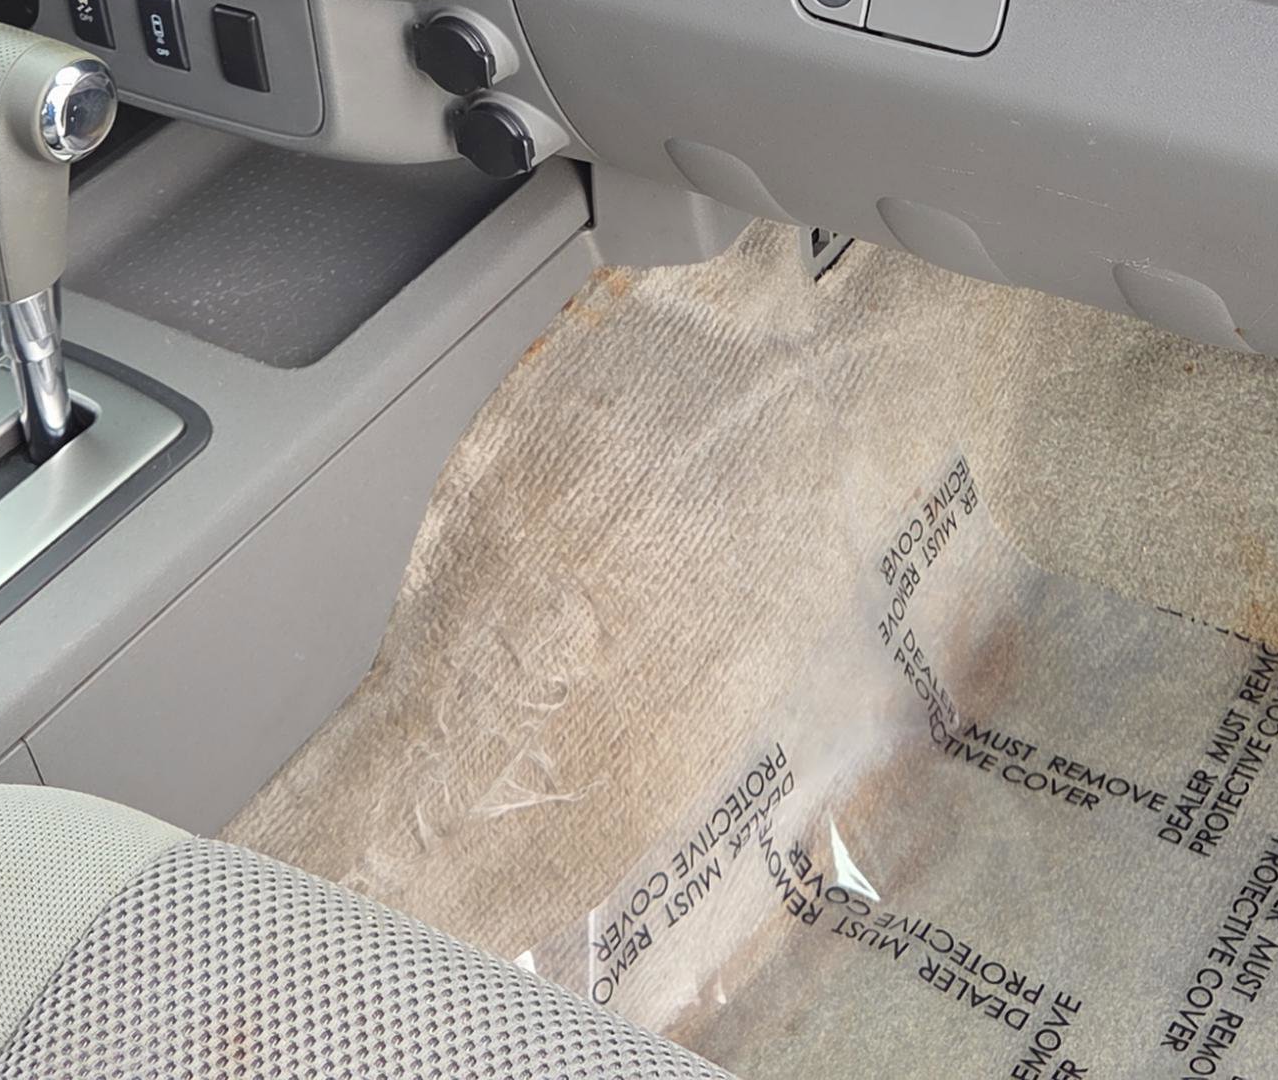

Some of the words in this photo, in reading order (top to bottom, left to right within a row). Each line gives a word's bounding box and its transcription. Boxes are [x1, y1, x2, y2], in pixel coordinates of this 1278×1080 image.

[879, 519, 923, 586] COVER
[922, 510, 958, 568] MUST
[878, 562, 921, 646] REMOVE
[894, 647, 998, 772] PROTECTIVE
[1002, 764, 1101, 812] COVER
[964, 723, 1037, 762] MUST
[1047, 755, 1168, 813] REMOVE
[672, 742, 788, 880] PROTECTIVE
[1157, 769, 1219, 845] DEALER
[1205, 708, 1251, 764] MUST
[1188, 736, 1272, 857] PROTECTIVE
[664, 857, 722, 929] MUST
[759, 820, 824, 926] REMOVE
[788, 840, 871, 916] COVER
[592, 871, 669, 963] COVER
[831, 916, 910, 960] MUST
[873, 912, 1045, 1006] PROTECTIVE
[592, 923, 653, 1006] REMO
[918, 956, 1031, 1031] DEALER
[1160, 968, 1223, 1052] COVER
[1182, 1009, 1244, 1080] REMO
